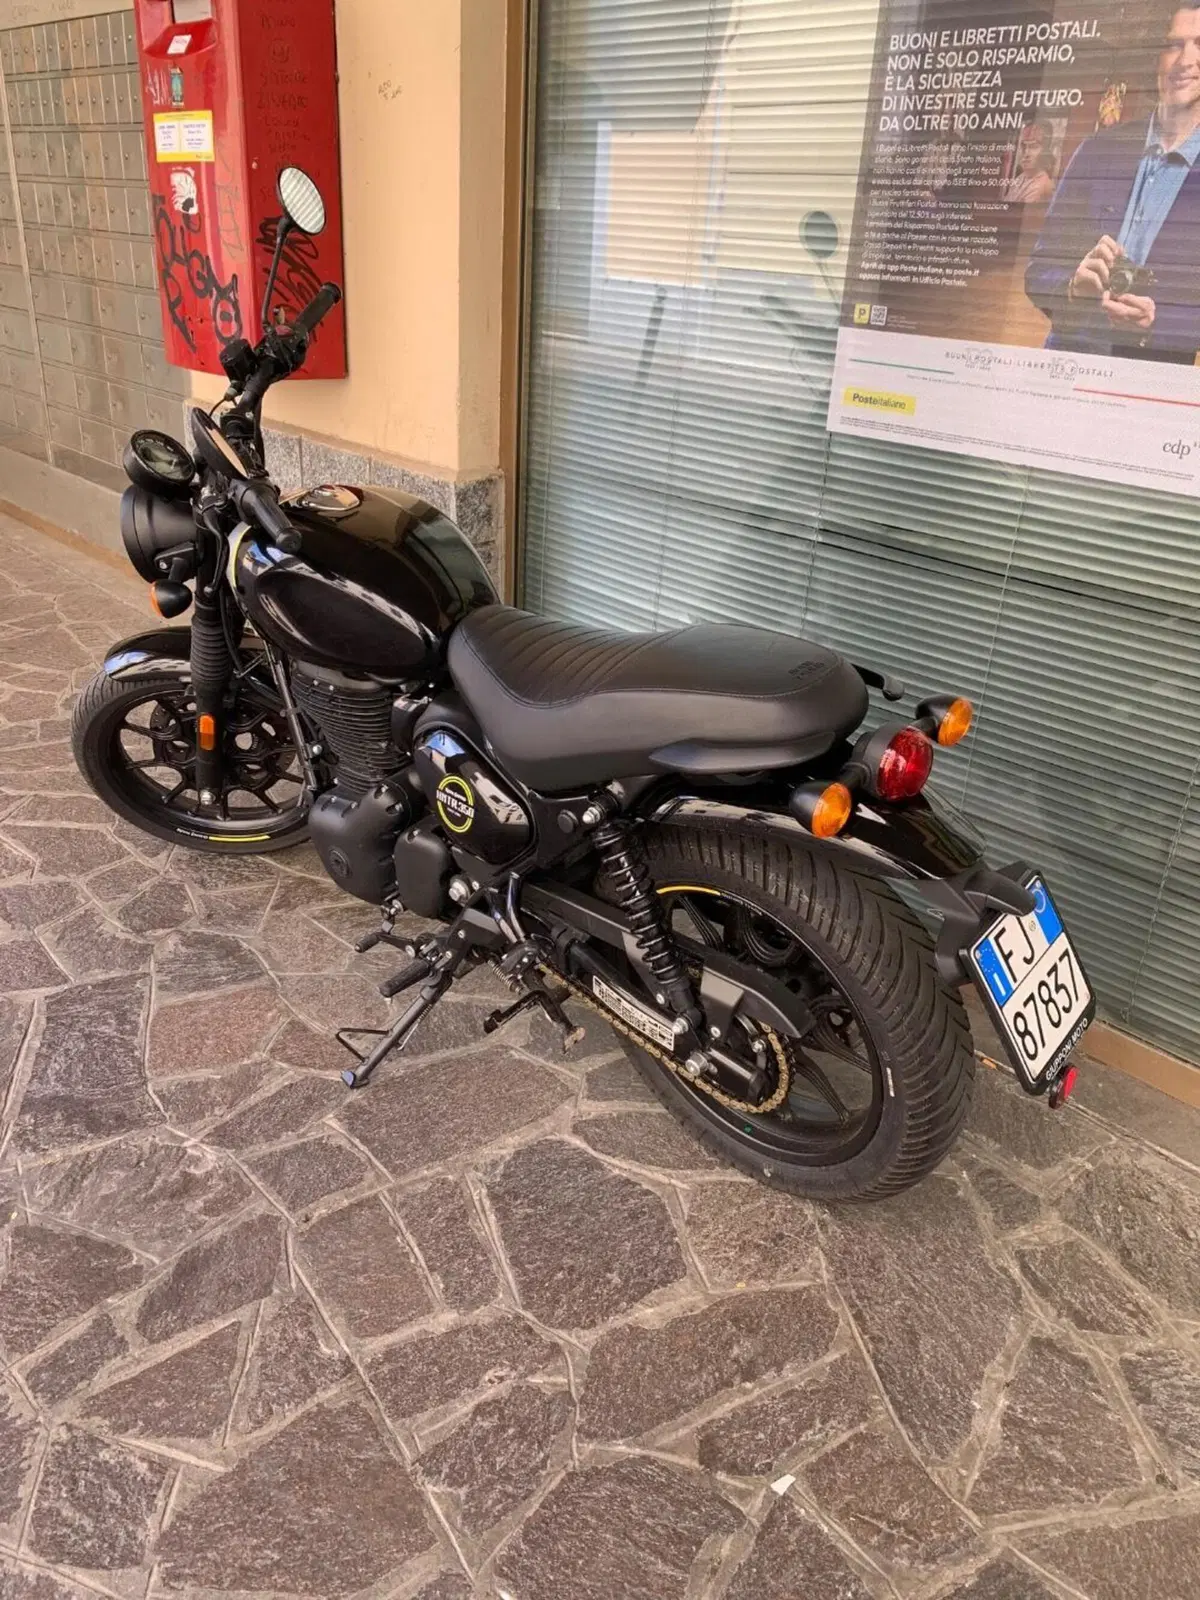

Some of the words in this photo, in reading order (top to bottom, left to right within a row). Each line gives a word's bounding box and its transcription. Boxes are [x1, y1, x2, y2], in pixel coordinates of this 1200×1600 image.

[890, 32, 938, 50] BUONI
[940, 30, 950, 48] E
[953, 25, 1023, 46] LIBRETTI
[1025, 20, 1101, 42] POSTALI.
[887, 54, 920, 72] NON
[924, 48, 934, 69] È
[936, 50, 980, 68] SOLO
[982, 44, 1076, 66] RISPARMIO,
[884, 71, 894, 91] È
[896, 75, 915, 91] LA
[918, 70, 1002, 90] SICUREZZA
[882, 96, 896, 111] DI
[900, 92, 976, 111] INVESTIRE
[979, 92, 1008, 108] SUL
[1012, 89, 1085, 108] FUTURO.
[880, 116, 900, 132] DA
[903, 114, 950, 131] OLTRE
[953, 113, 980, 130] 100
[982, 112, 1026, 129] ANNI.
[1162, 440, 1190, 460] cdp
[1013, 948, 1078, 1061] 87837
[1072, 1018, 1088, 1044] MOTO
